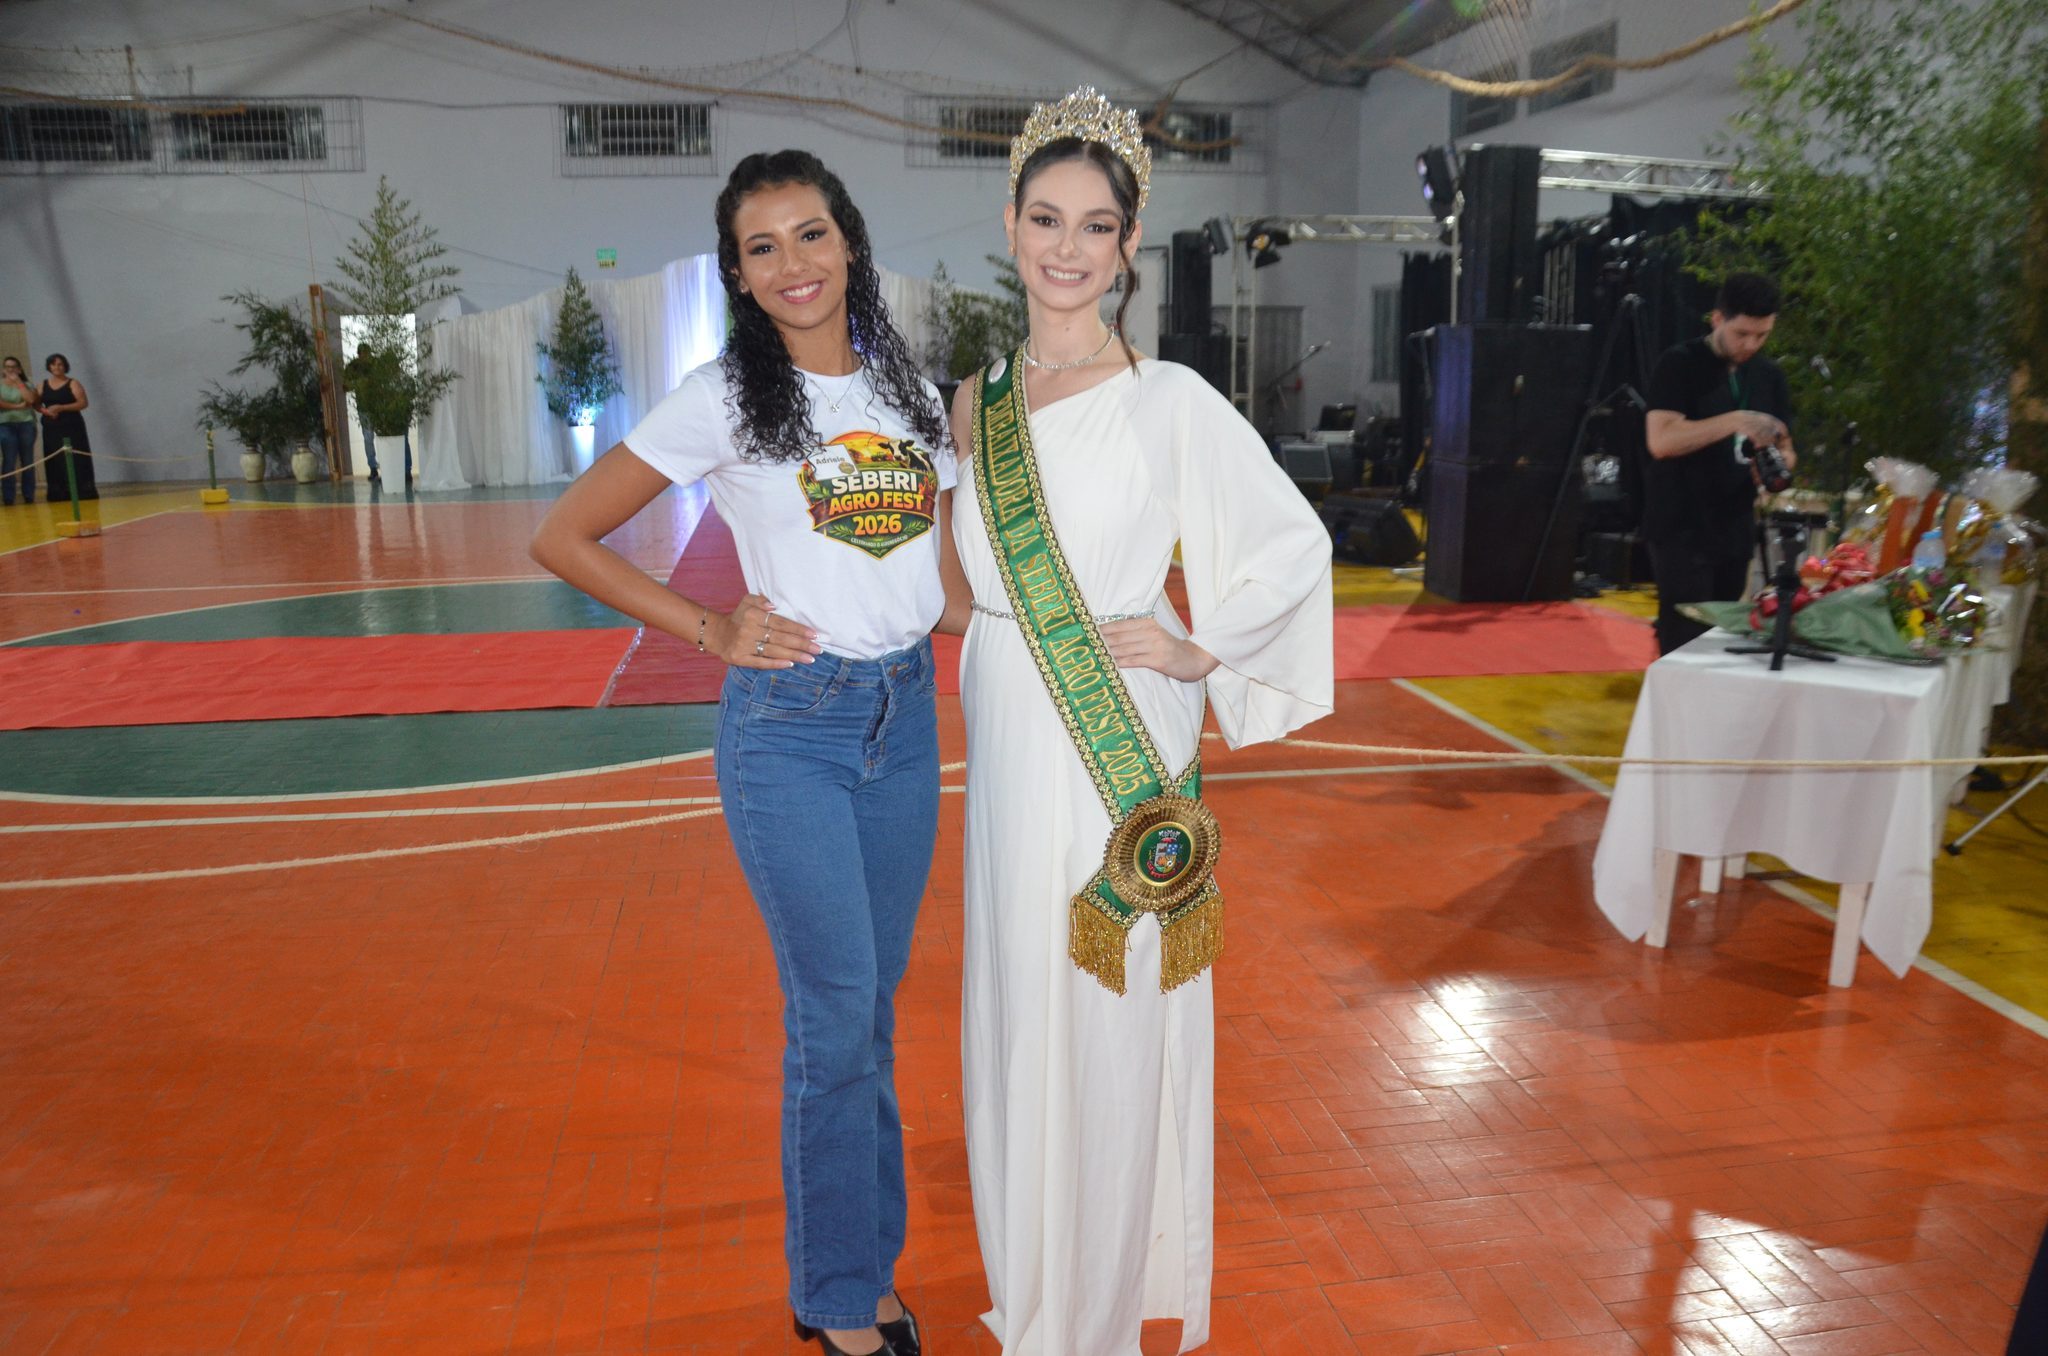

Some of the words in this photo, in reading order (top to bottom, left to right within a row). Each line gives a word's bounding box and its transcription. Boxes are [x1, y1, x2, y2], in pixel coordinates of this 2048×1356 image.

[831, 470, 918, 495] SEBERI
[984, 390, 1032, 526] EMBAIXADORA
[828, 491, 880, 516] AGRO
[882, 491, 924, 511] FEST
[852, 513, 902, 536] 2026
[1004, 516, 1041, 556] DA
[1015, 553, 1076, 636] SEBERI
[1048, 635, 1102, 691] AGRO
[1073, 686, 1127, 744] FEST
[1099, 740, 1153, 796] 2025
